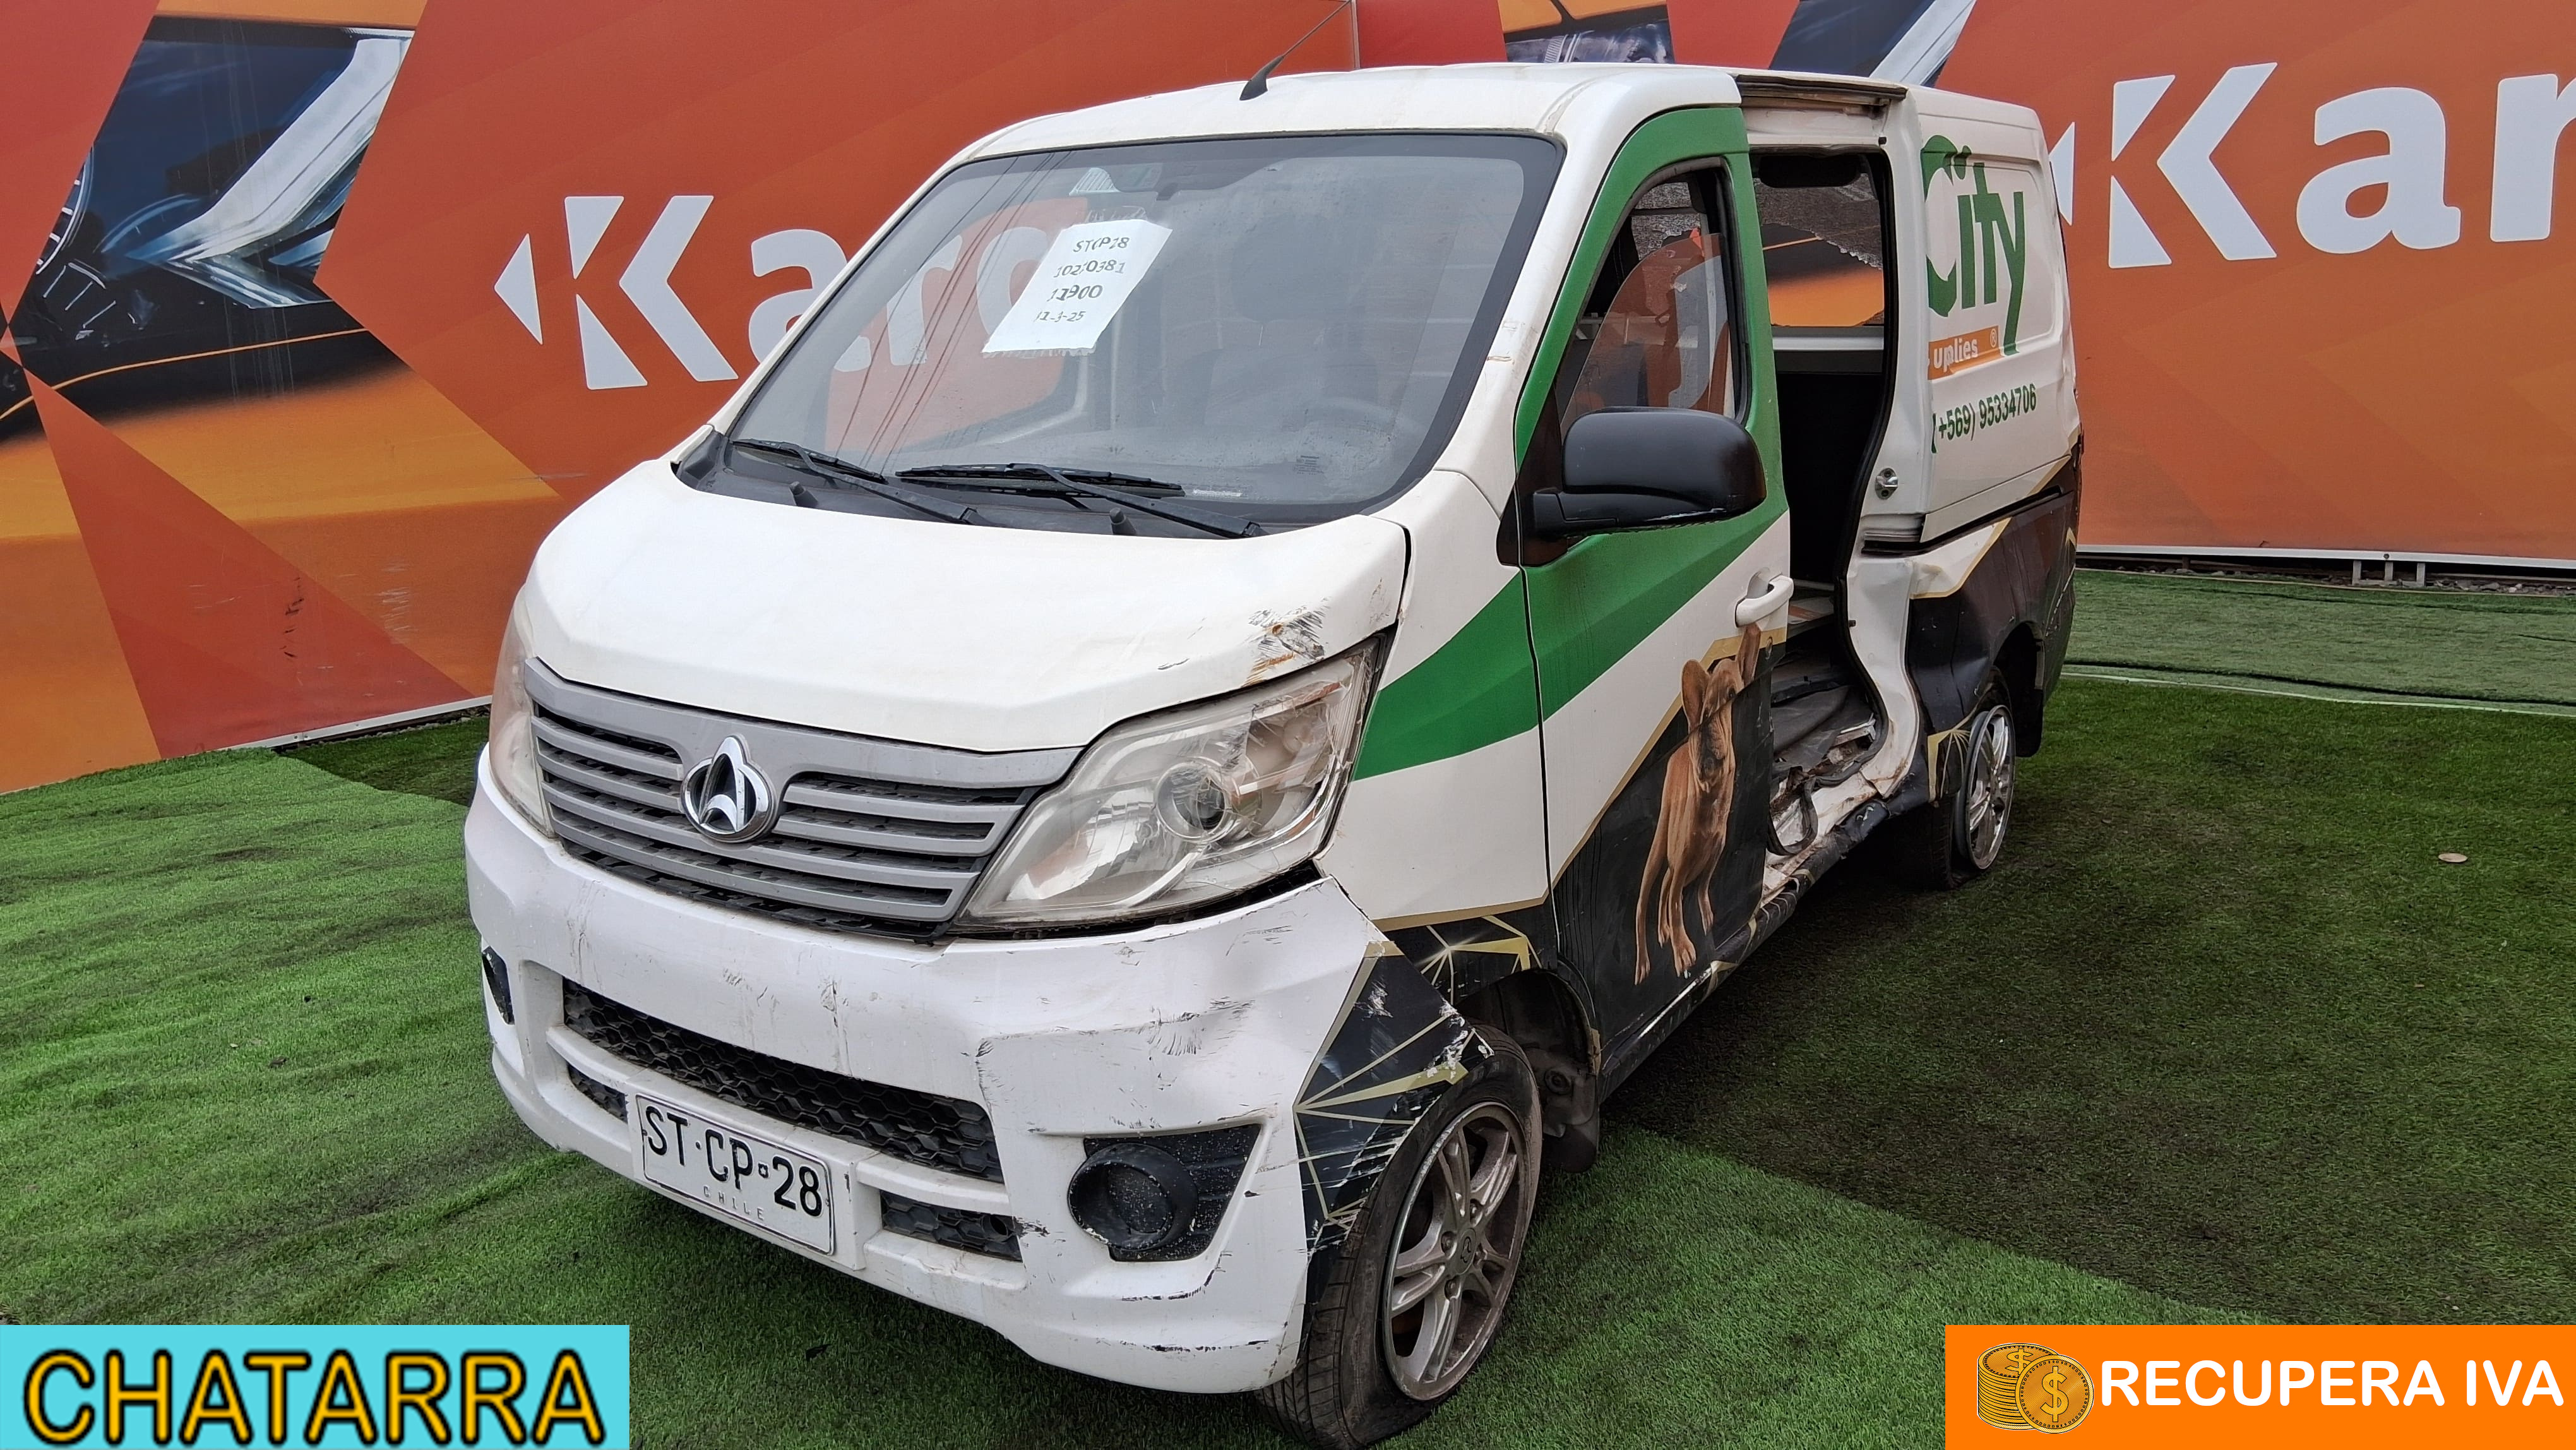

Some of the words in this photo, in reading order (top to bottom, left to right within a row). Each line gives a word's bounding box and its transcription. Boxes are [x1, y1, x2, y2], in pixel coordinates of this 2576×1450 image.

[1921, 135, 2025, 356] City
[1928, 338, 1978, 373] uplies
[1979, 382, 2037, 429] 95334706
[703, 1185, 765, 1222] CHILE
